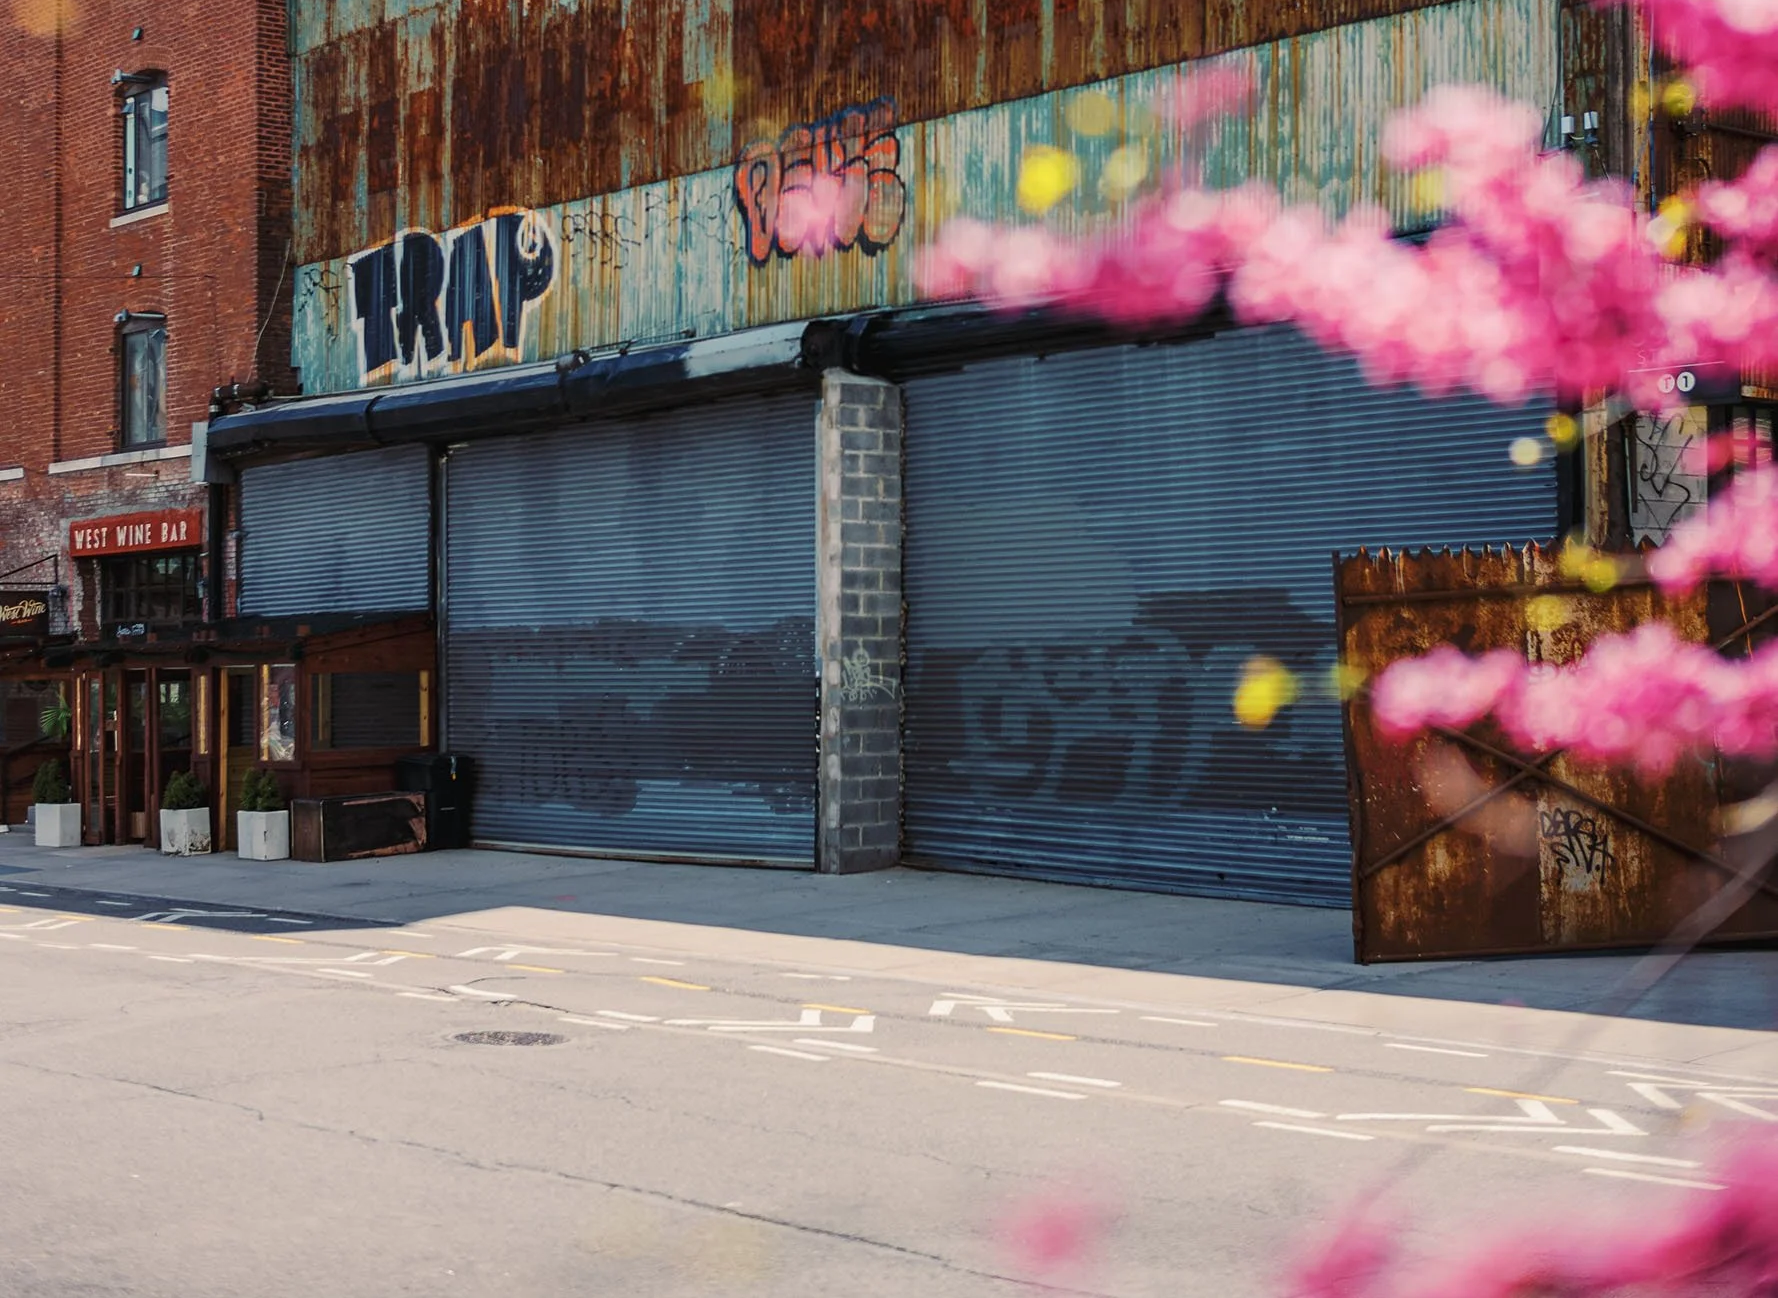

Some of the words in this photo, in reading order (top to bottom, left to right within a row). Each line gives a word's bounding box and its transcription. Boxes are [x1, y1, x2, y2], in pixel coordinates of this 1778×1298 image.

[74, 527, 108, 550] WEST
[116, 523, 152, 547] WINE
[161, 520, 188, 543] BAR
[19, 599, 47, 619] Wine
